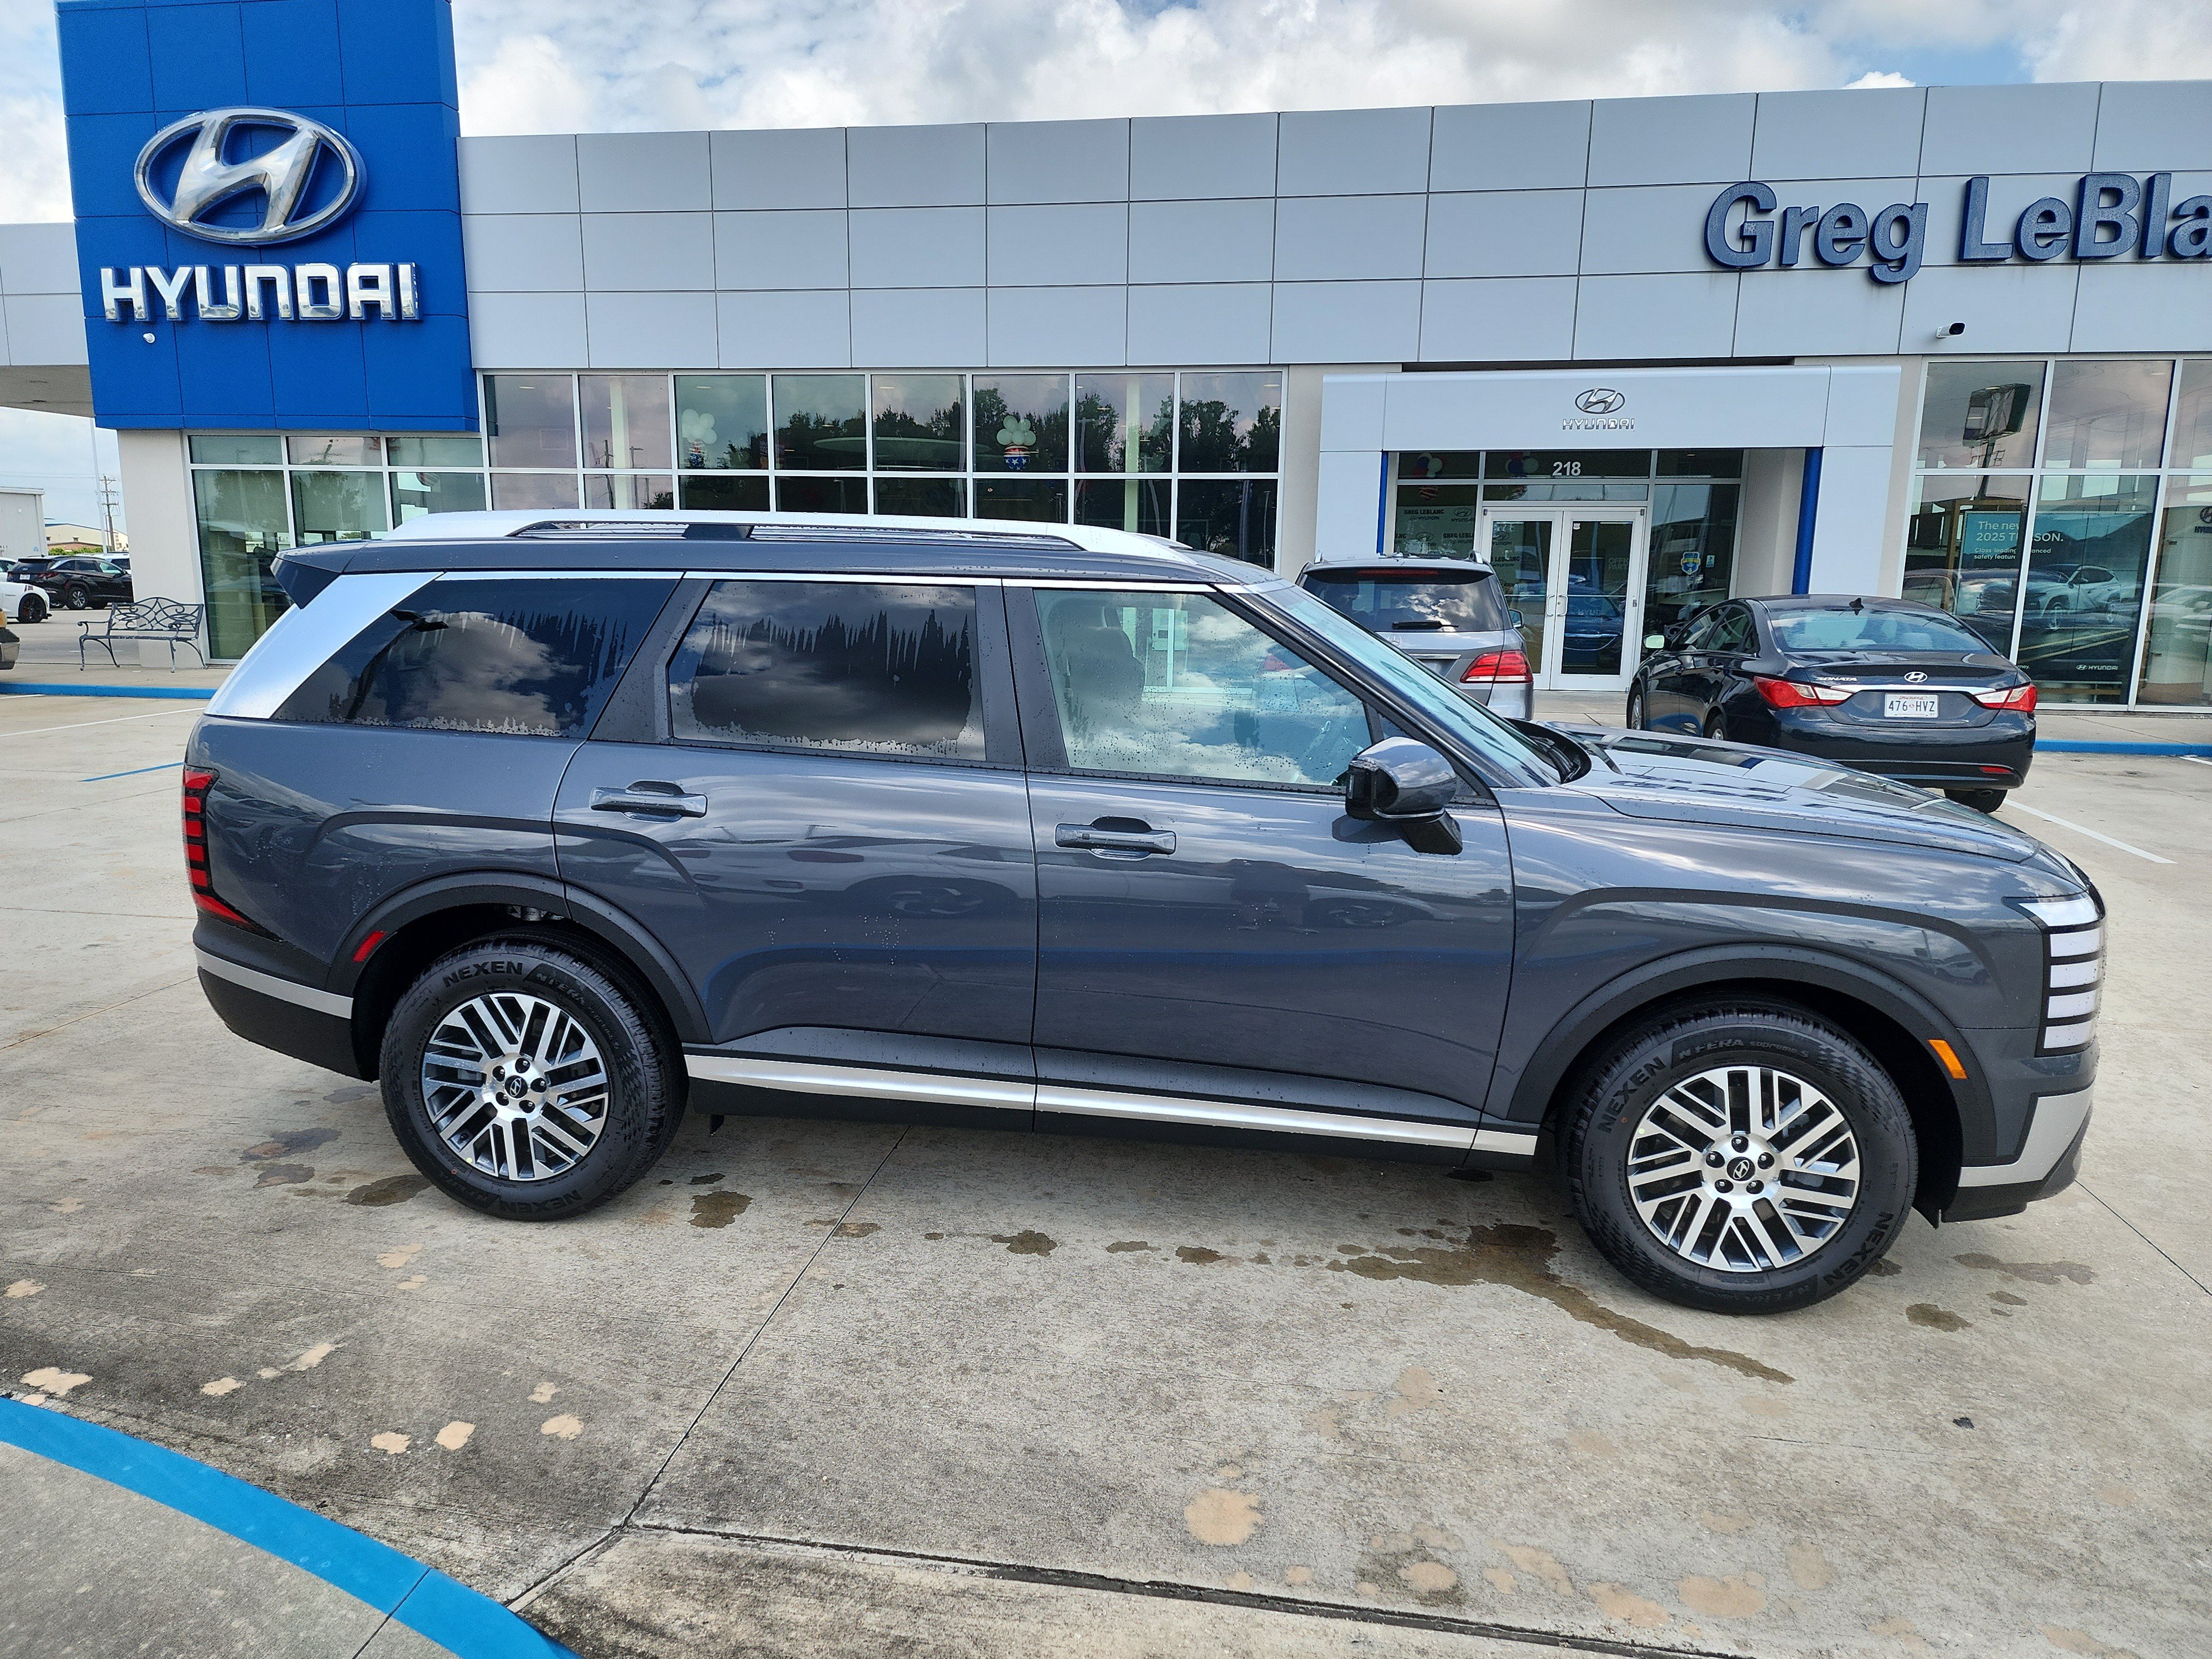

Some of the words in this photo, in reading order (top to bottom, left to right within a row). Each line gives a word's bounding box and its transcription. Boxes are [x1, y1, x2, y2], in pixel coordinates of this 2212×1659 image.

[1704, 181, 1929, 285] Greg
[101, 262, 421, 322] HYUNDAI
[1562, 418, 1635, 430] HYUNDAI
[1552, 461, 1582, 476] 218
[1978, 521, 1999, 530] The
[1976, 532, 2006, 541] 2025
[1888, 700, 1908, 712] 476
[1916, 701, 1936, 712] HVZ
[443, 961, 523, 988] NEXEN
[1597, 1056, 1666, 1134] NEXEN
[1823, 1212, 1895, 1286] NEXEN
